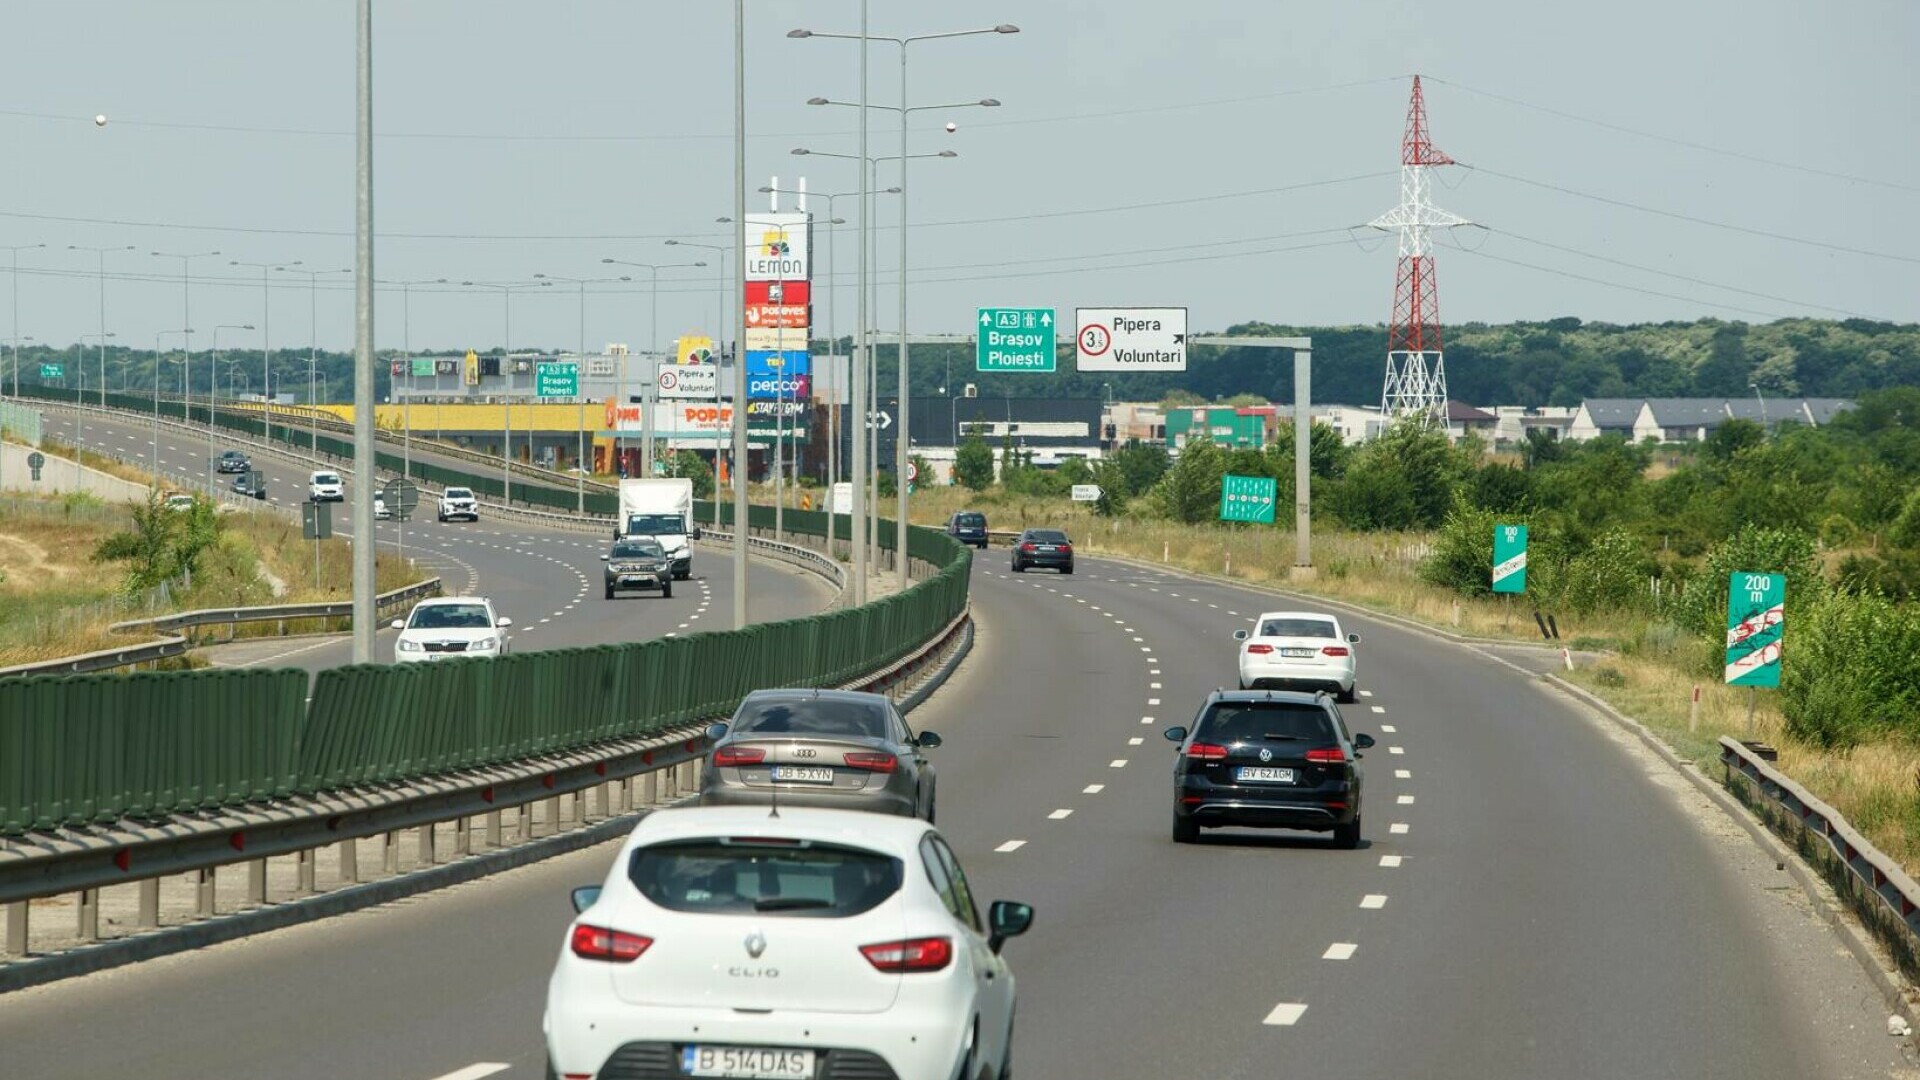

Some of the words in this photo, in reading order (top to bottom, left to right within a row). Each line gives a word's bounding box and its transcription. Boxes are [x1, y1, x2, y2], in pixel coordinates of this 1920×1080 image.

[750, 260, 802, 274] LEMON
[1000, 314, 1017, 326] A3
[1113, 317, 1161, 335] Pipera
[988, 331, 1043, 348] Brașov
[988, 351, 1044, 368] Ploiești
[1113, 349, 1181, 363] Voluntari
[678, 369, 704, 379] Pipera
[751, 380, 800, 394] pepco
[1504, 526, 1518, 536] 100
[1745, 575, 1770, 591] 200
[1750, 591, 1763, 603] m
[808, 768, 831, 780] XYN
[1243, 768, 1256, 777] BV
[1260, 769, 1272, 777] 62
[1273, 770, 1292, 779] AGM
[728, 967, 780, 978] CLIO
[700, 1050, 714, 1070] B
[724, 1051, 756, 1070] 514
[760, 1051, 804, 1073] DAS
